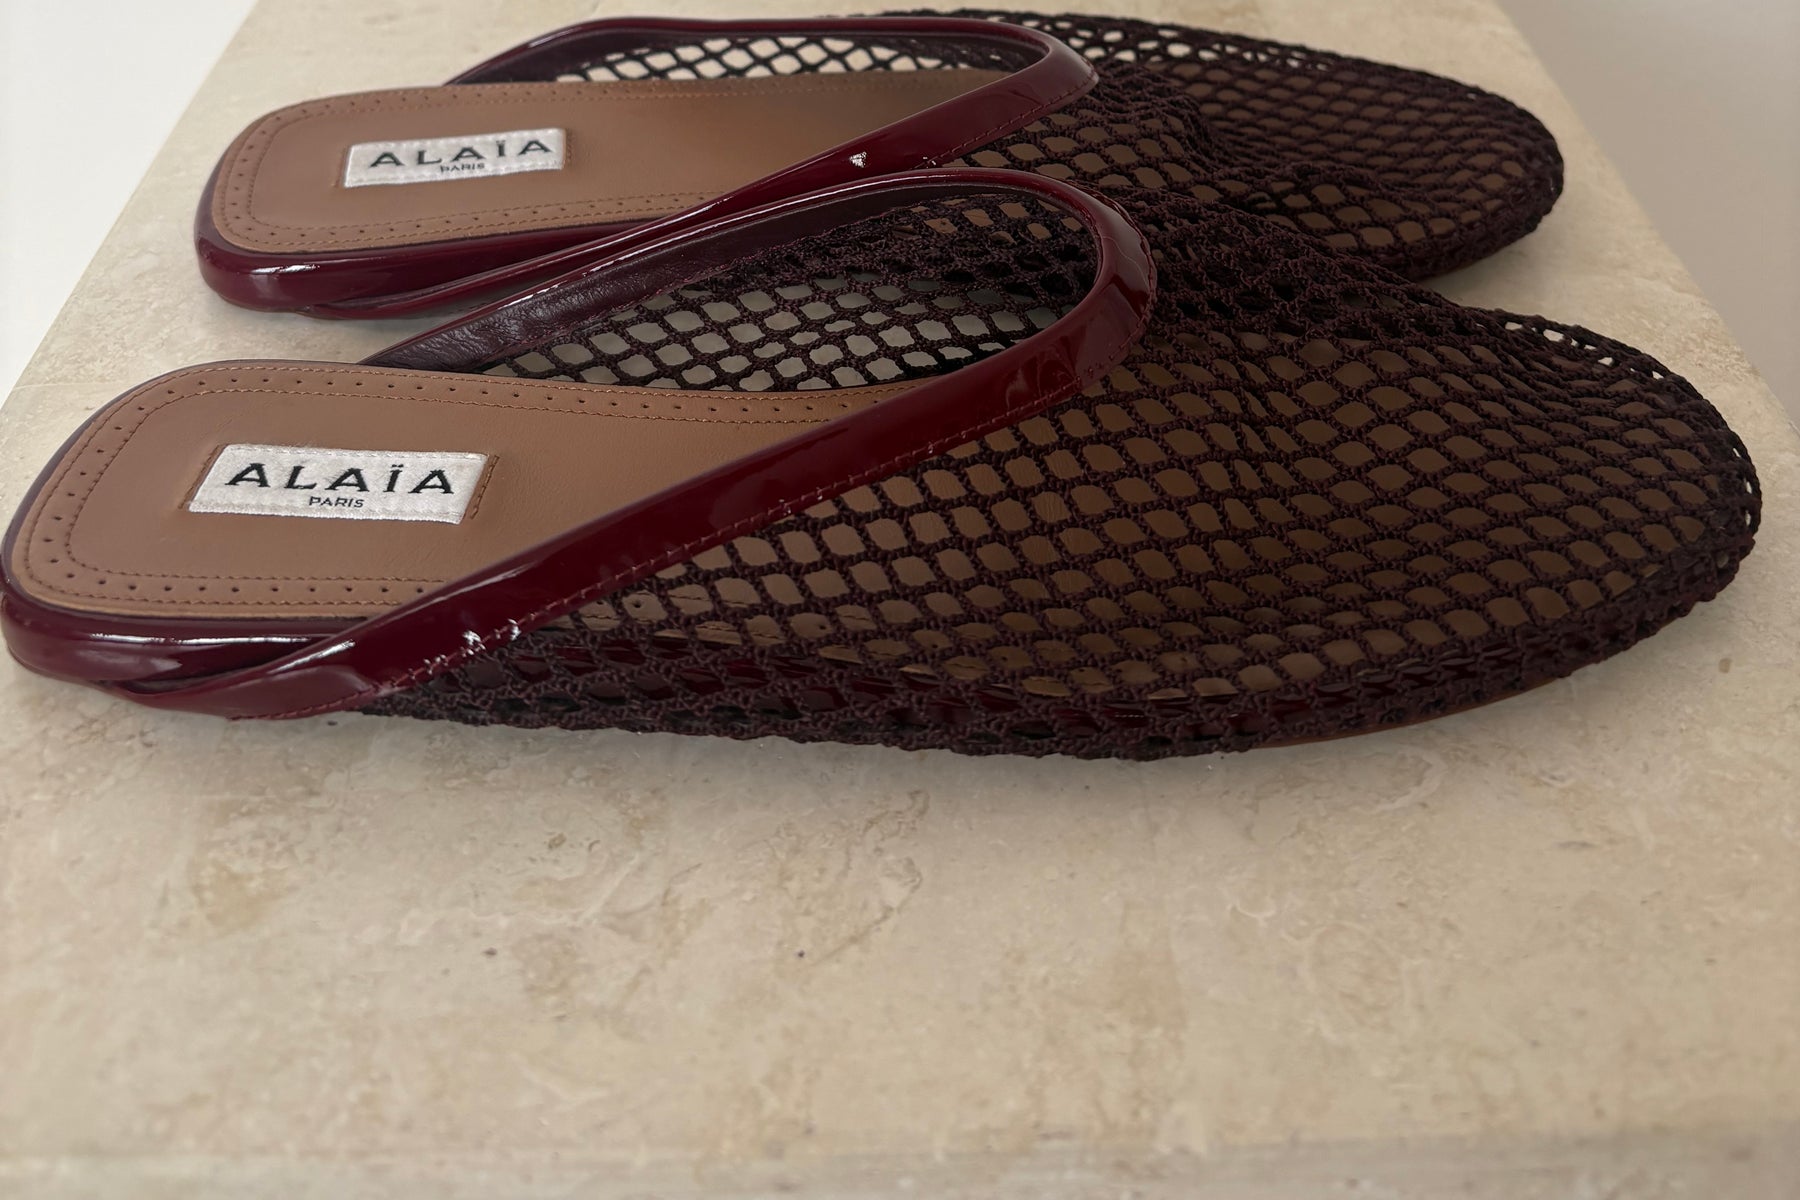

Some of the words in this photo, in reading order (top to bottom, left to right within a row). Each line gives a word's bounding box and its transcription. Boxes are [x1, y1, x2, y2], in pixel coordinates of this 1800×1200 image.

[440, 162, 486, 173] PARIS
[224, 461, 455, 495] ALAÏA
[308, 495, 366, 509] PARIS
